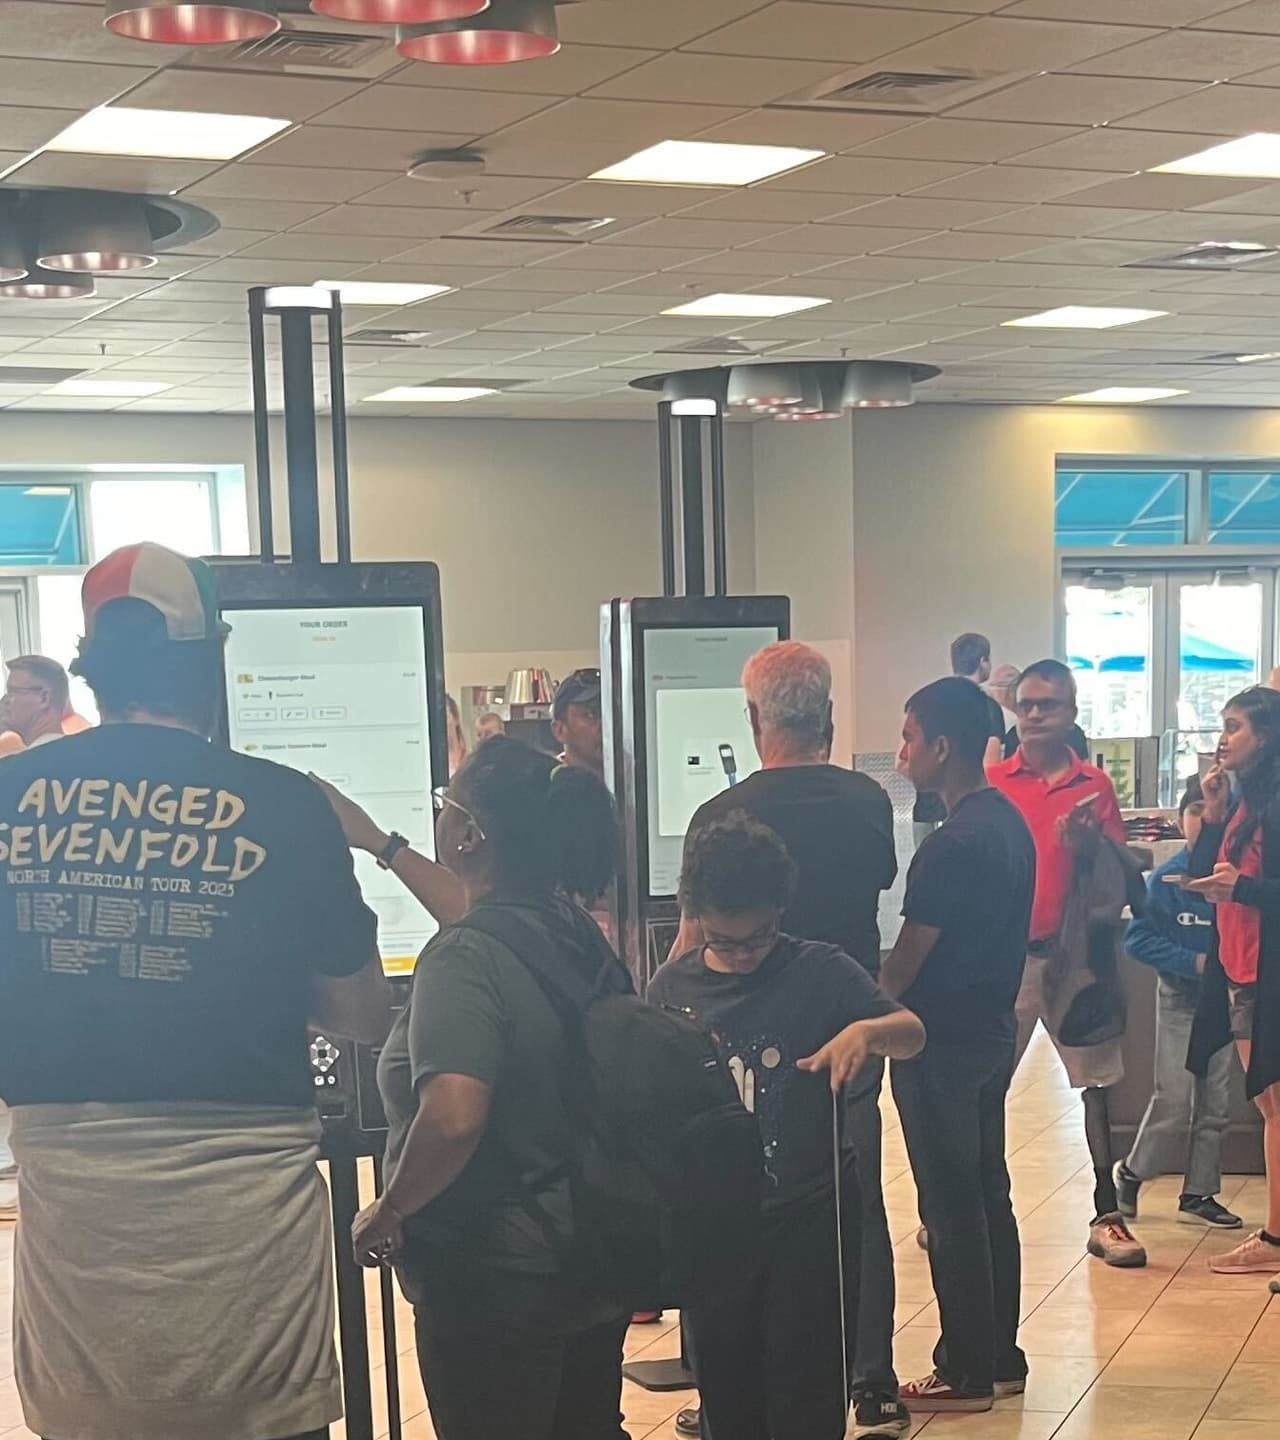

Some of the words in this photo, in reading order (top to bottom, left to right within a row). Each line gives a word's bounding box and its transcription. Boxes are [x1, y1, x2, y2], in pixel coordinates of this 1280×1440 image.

[18, 777, 246, 831] AVENGED
[58, 870, 145, 890] AMERICAN
[150, 876, 192, 894] TOUR
